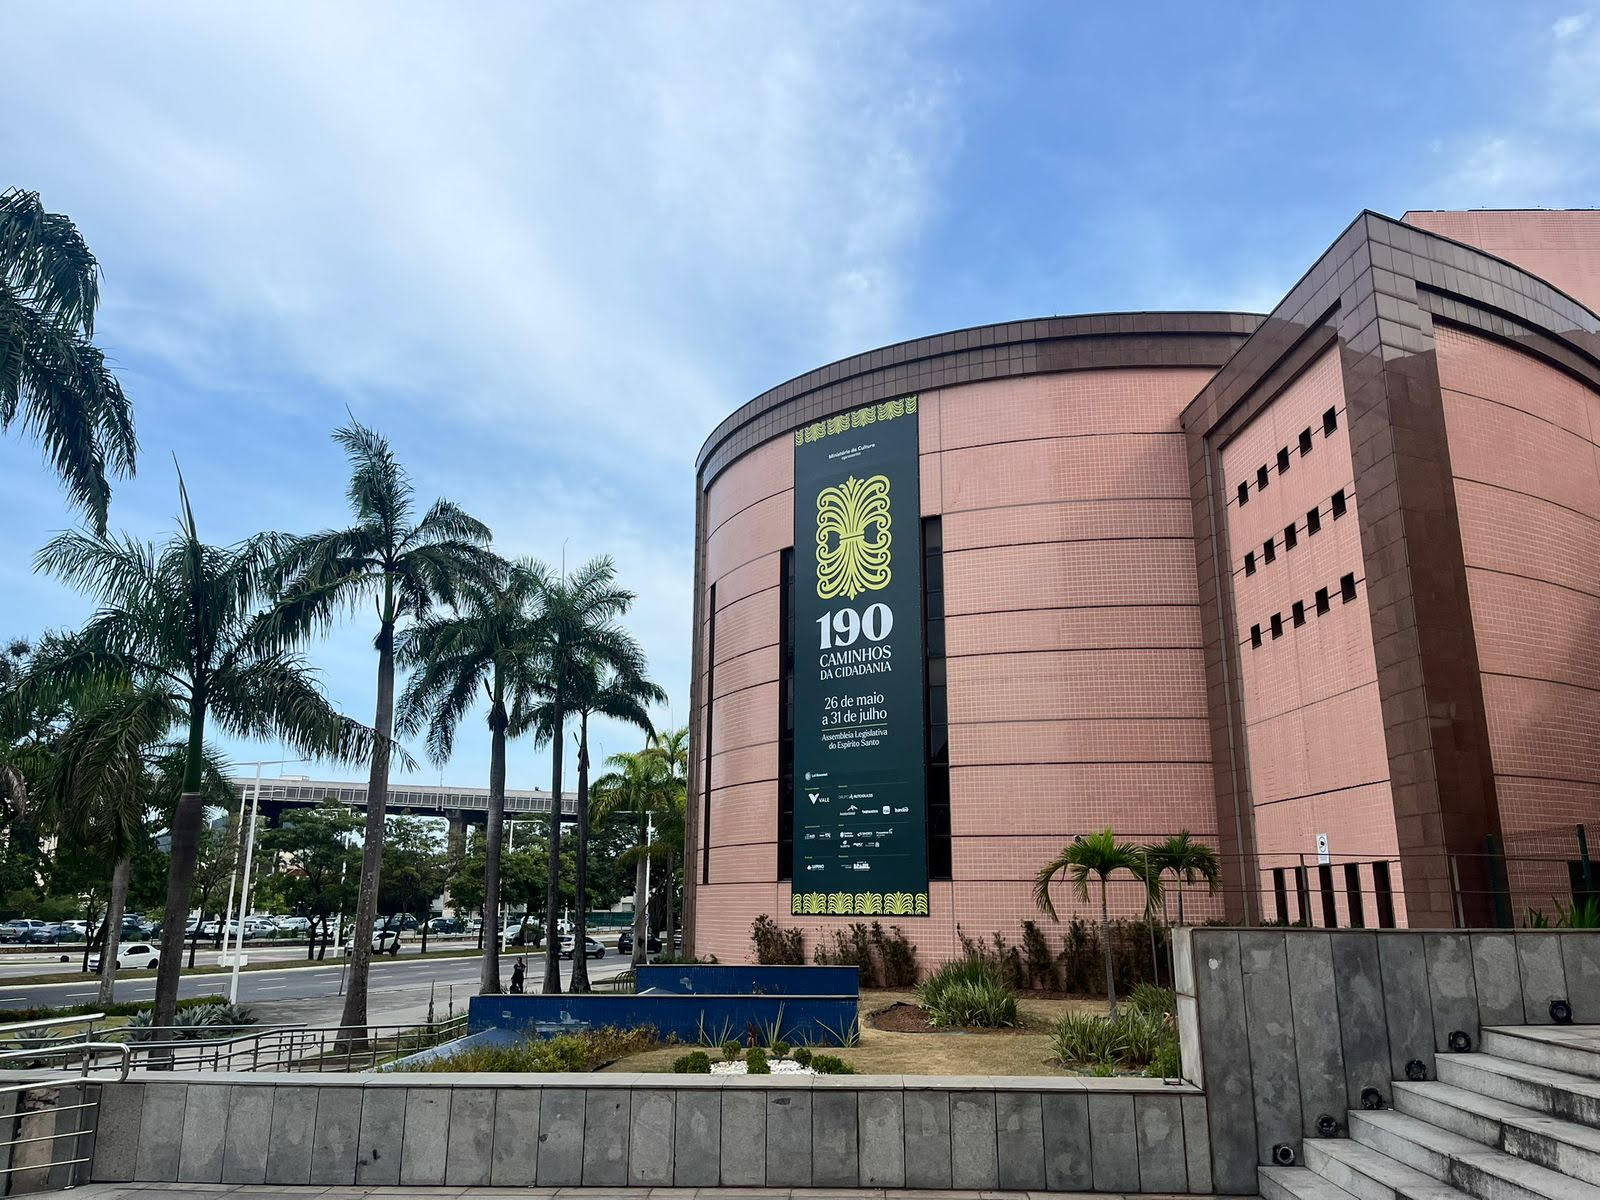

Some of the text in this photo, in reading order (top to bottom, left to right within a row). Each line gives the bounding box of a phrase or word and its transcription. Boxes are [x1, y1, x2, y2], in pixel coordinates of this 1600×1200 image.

[857, 443, 875, 451] Cultura
[816, 603, 893, 650] 190
[820, 645, 891, 667] CAMINHOS
[820, 661, 891, 681] DA CIDADANIA
[824, 691, 884, 710] 26 de maio
[821, 707, 887, 725] a 31 de julho
[821, 728, 888, 741] Assembleia Legislativa
[860, 738, 880, 747] Santo
